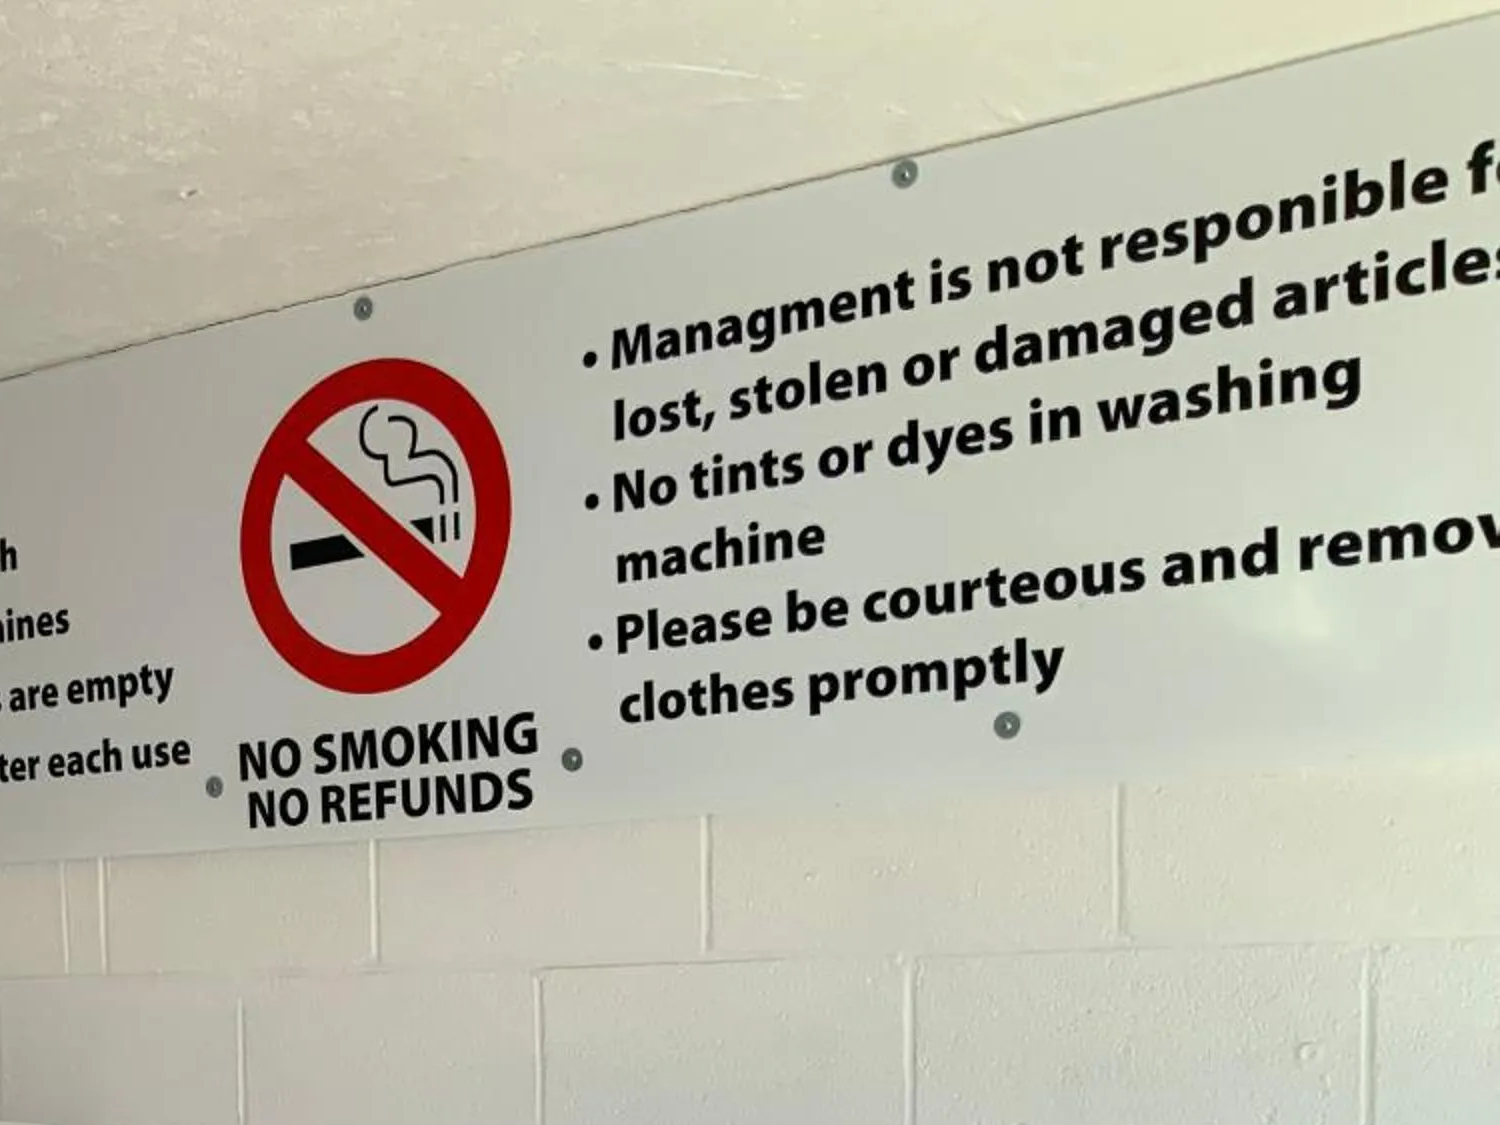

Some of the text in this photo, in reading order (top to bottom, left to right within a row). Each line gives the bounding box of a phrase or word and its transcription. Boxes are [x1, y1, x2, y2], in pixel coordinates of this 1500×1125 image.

[611, 139, 1500, 371] Managment is not responible f
[613, 238, 1500, 442] lost, stolen or damaged article
[613, 357, 1361, 513] No tints or dyes in washing
[616, 521, 826, 584] machine
[616, 605, 773, 655] Please
[786, 589, 849, 634] be
[863, 557, 1146, 623] courteous
[1161, 525, 1279, 587] and
[8, 682, 60, 713] are
[66, 663, 175, 709] empty
[619, 637, 1065, 724] clothes promptly
[47, 737, 123, 779] each
[131, 739, 191, 771] use
[238, 711, 539, 783] NO SMOKING
[247, 767, 534, 830] NO REFUNDS
